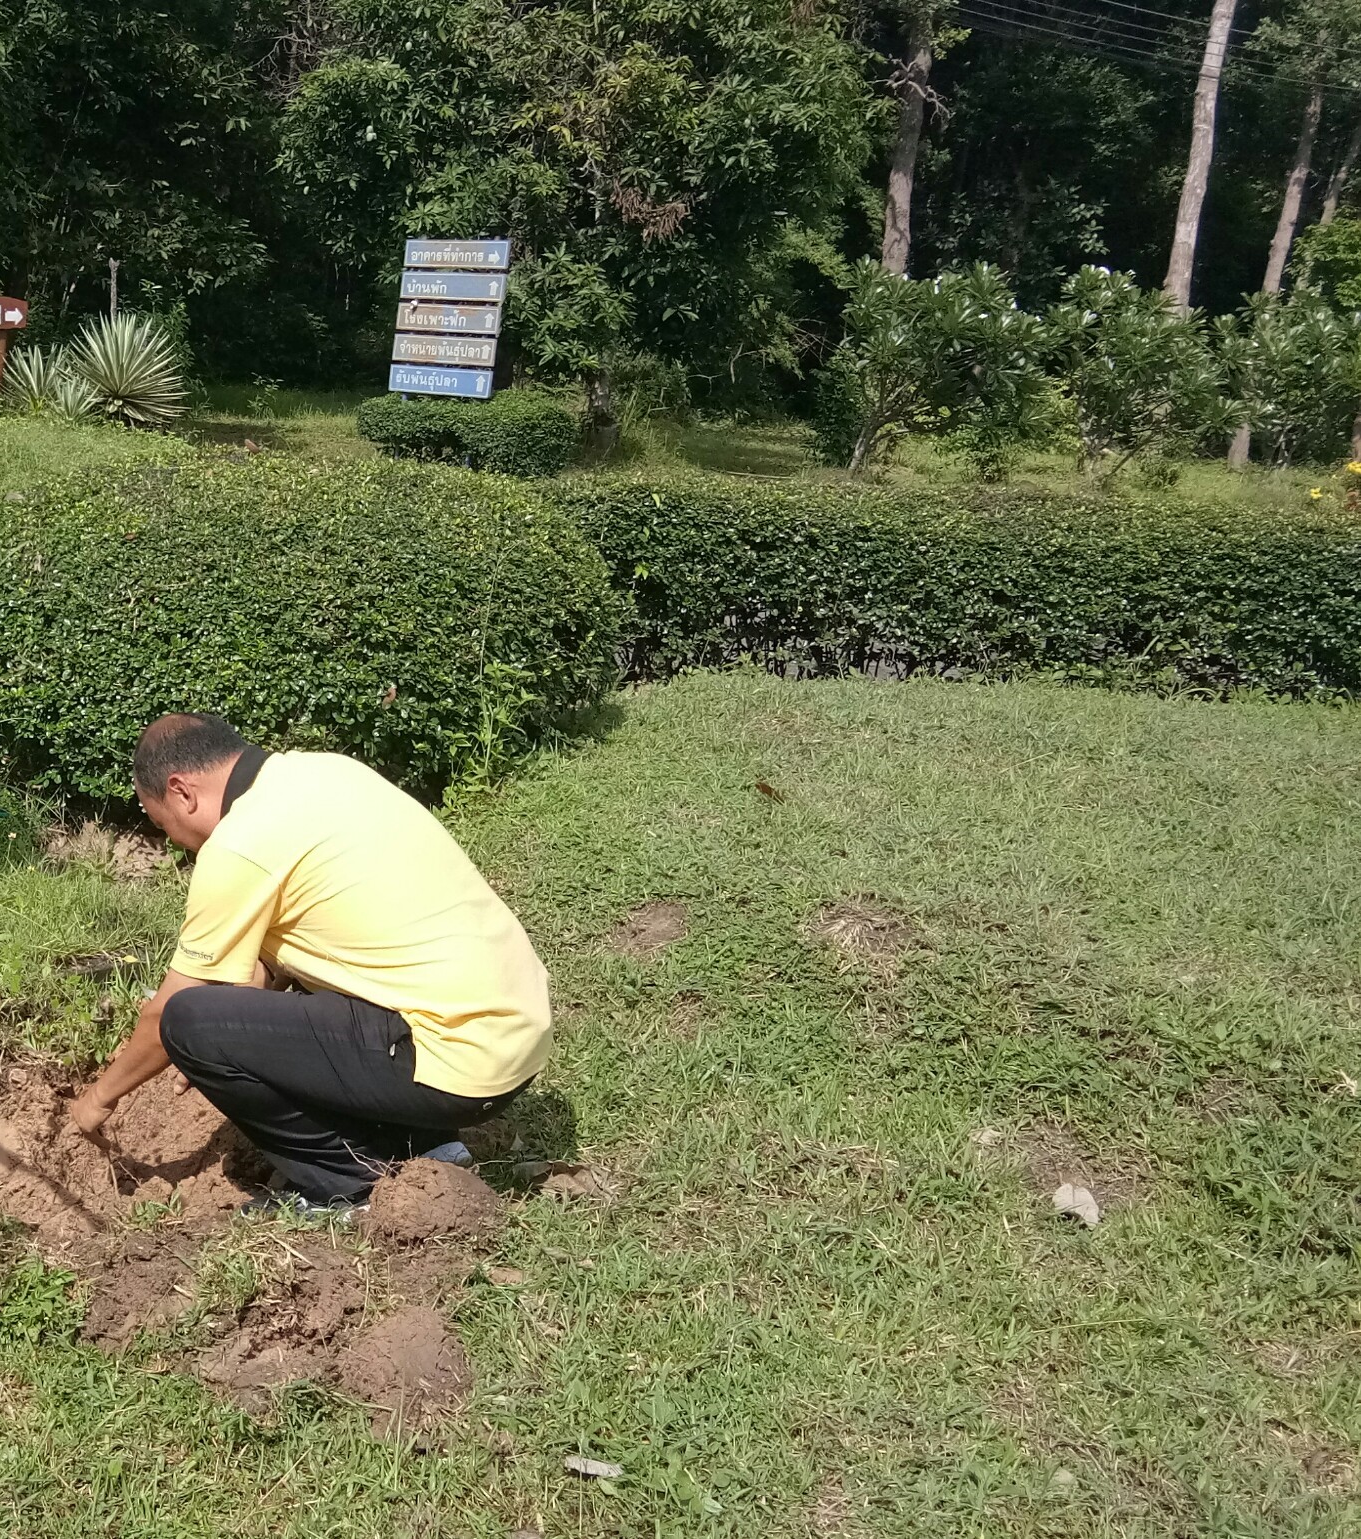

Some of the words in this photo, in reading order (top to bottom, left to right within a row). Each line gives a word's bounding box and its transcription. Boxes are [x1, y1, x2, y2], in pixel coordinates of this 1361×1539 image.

[411, 244, 484, 262] อาคารที่ทำการ
[407, 279, 447, 295] บ้านพัก
[404, 309, 467, 327] โรงเพาะฟัก
[400, 340, 481, 362] จำหน่ายพันธุ์ปลา
